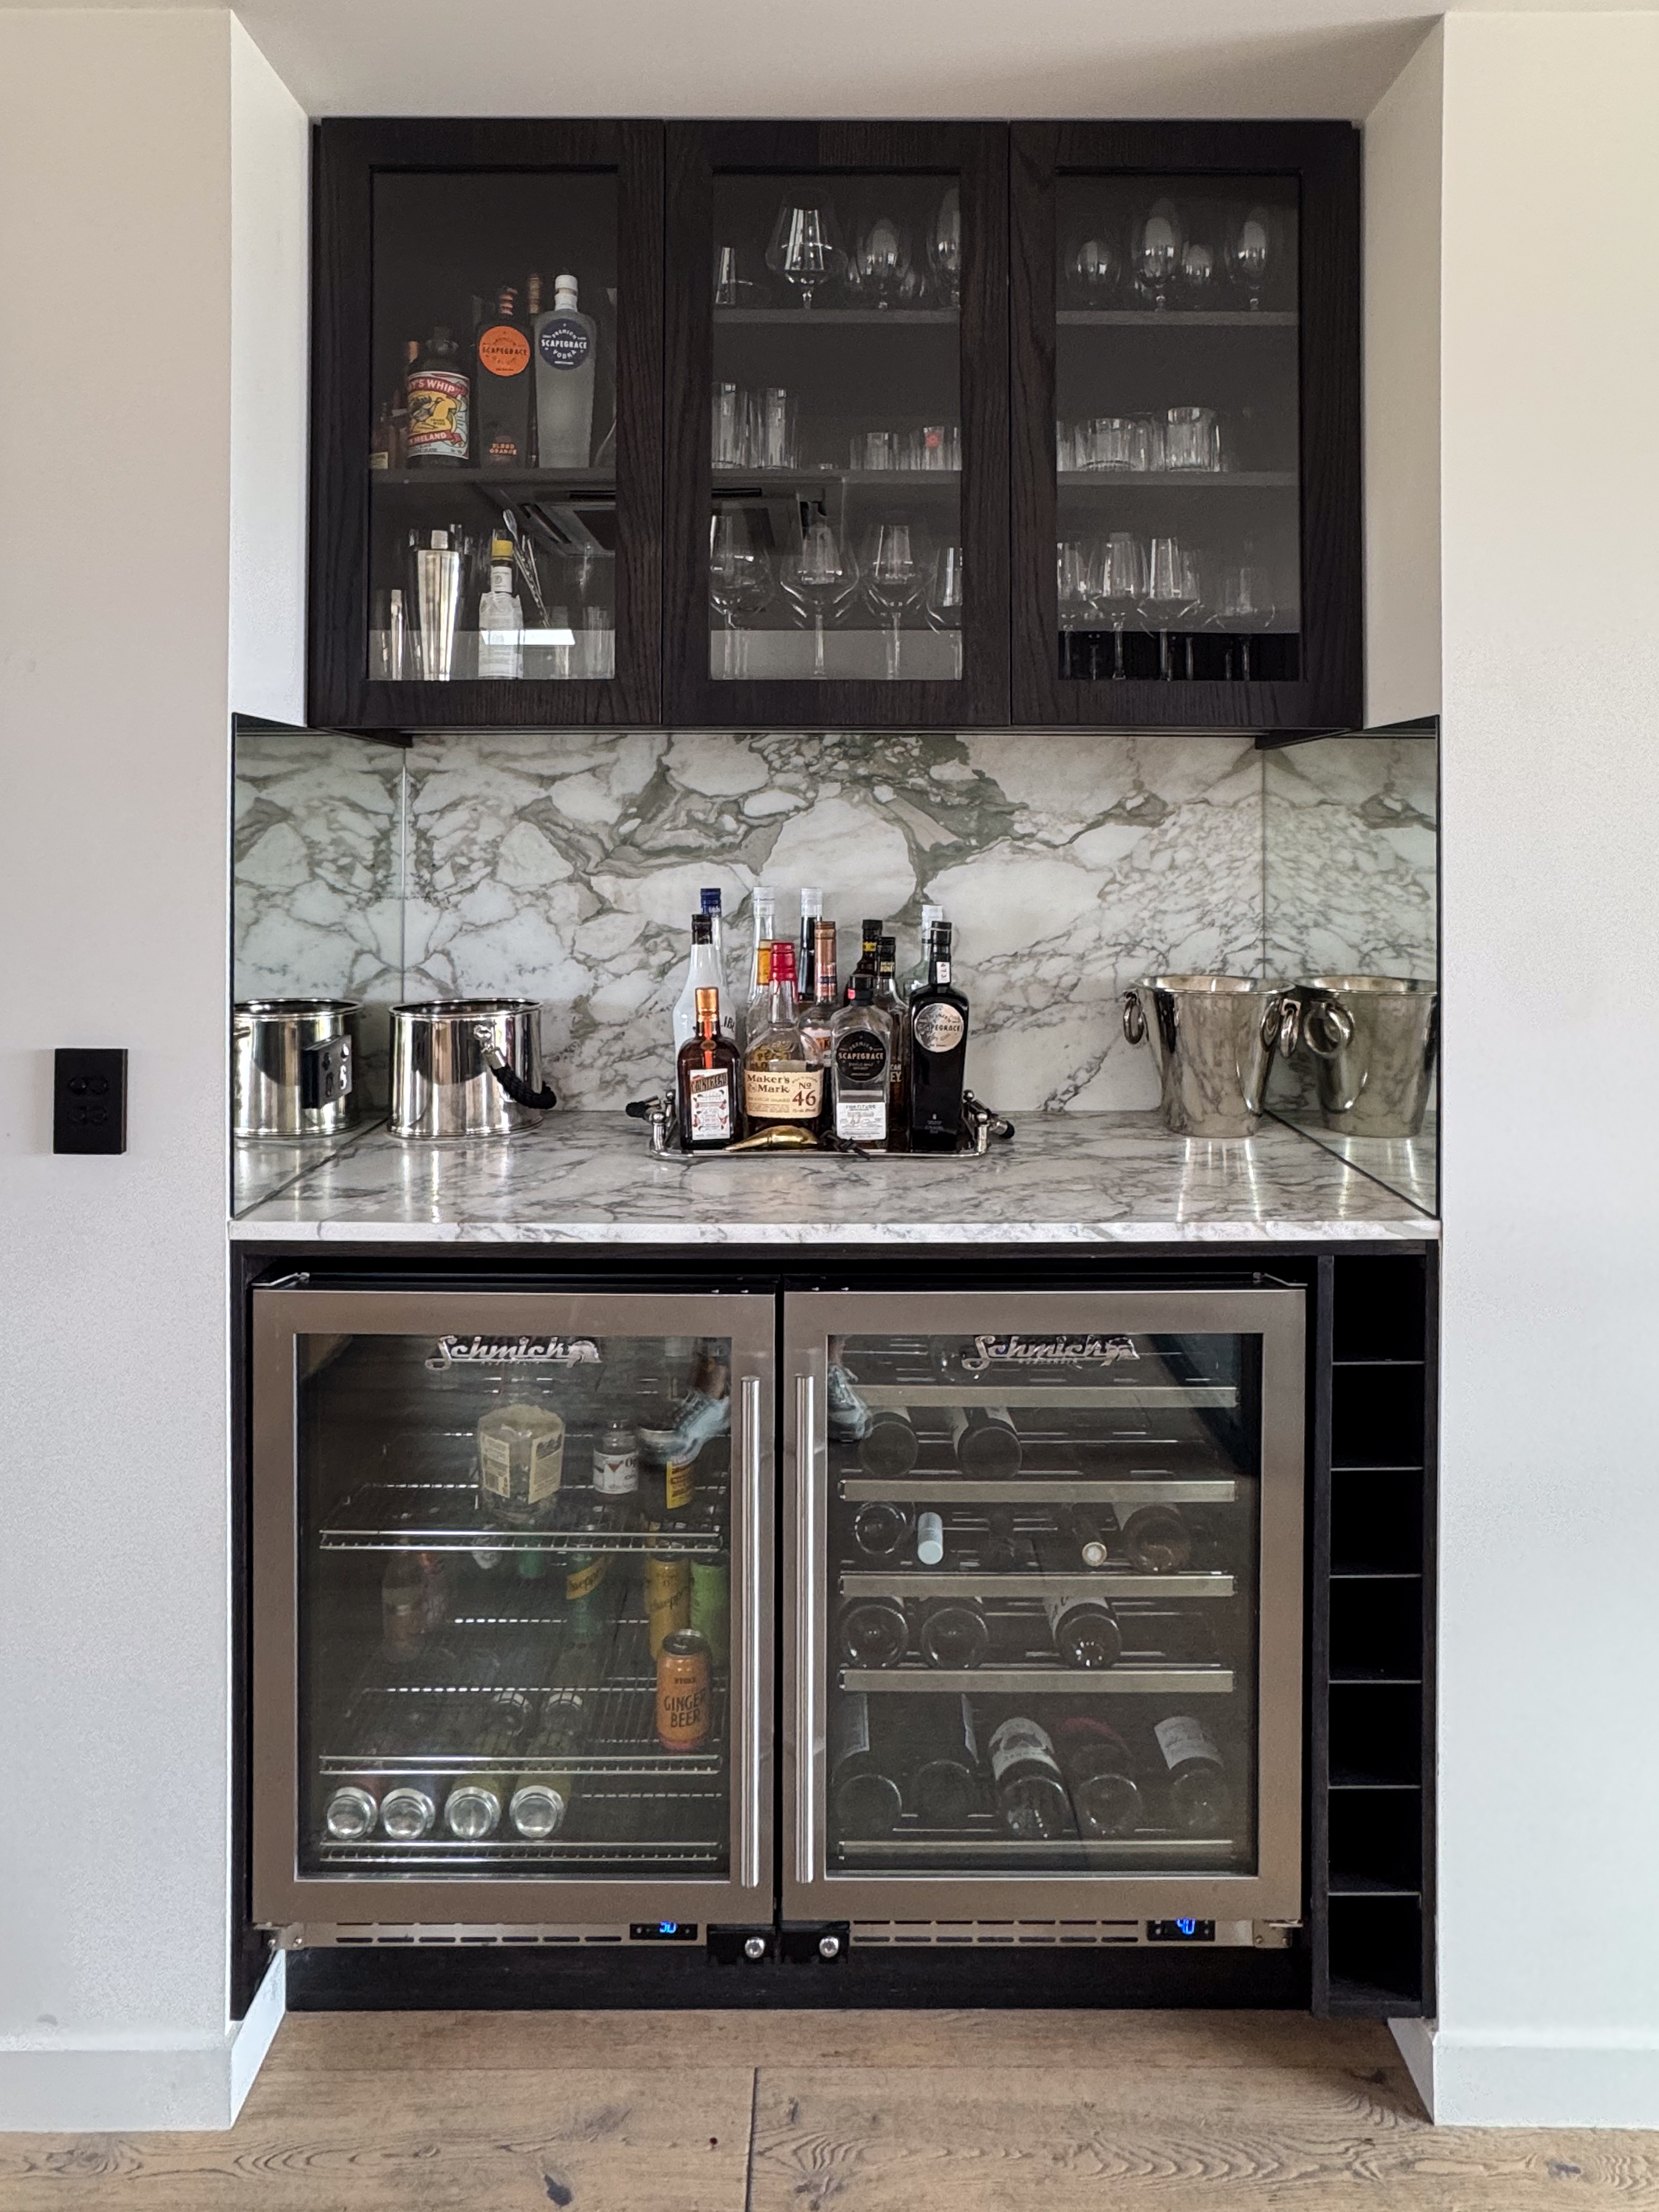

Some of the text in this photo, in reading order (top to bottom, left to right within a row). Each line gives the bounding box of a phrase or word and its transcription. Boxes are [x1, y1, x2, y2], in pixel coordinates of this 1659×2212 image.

[541, 339, 587, 350] SCAPEGRACE
[553, 349, 577, 359] VODKA
[427, 379, 455, 394] WHIP
[747, 1075, 790, 1084] Maker's
[757, 1084, 790, 1093] Mark
[792, 1090, 816, 1106] 46
[425, 1335, 570, 1370] Schmick
[664, 1687, 706, 1712] GINGER
[671, 1708, 700, 1728] BEER
